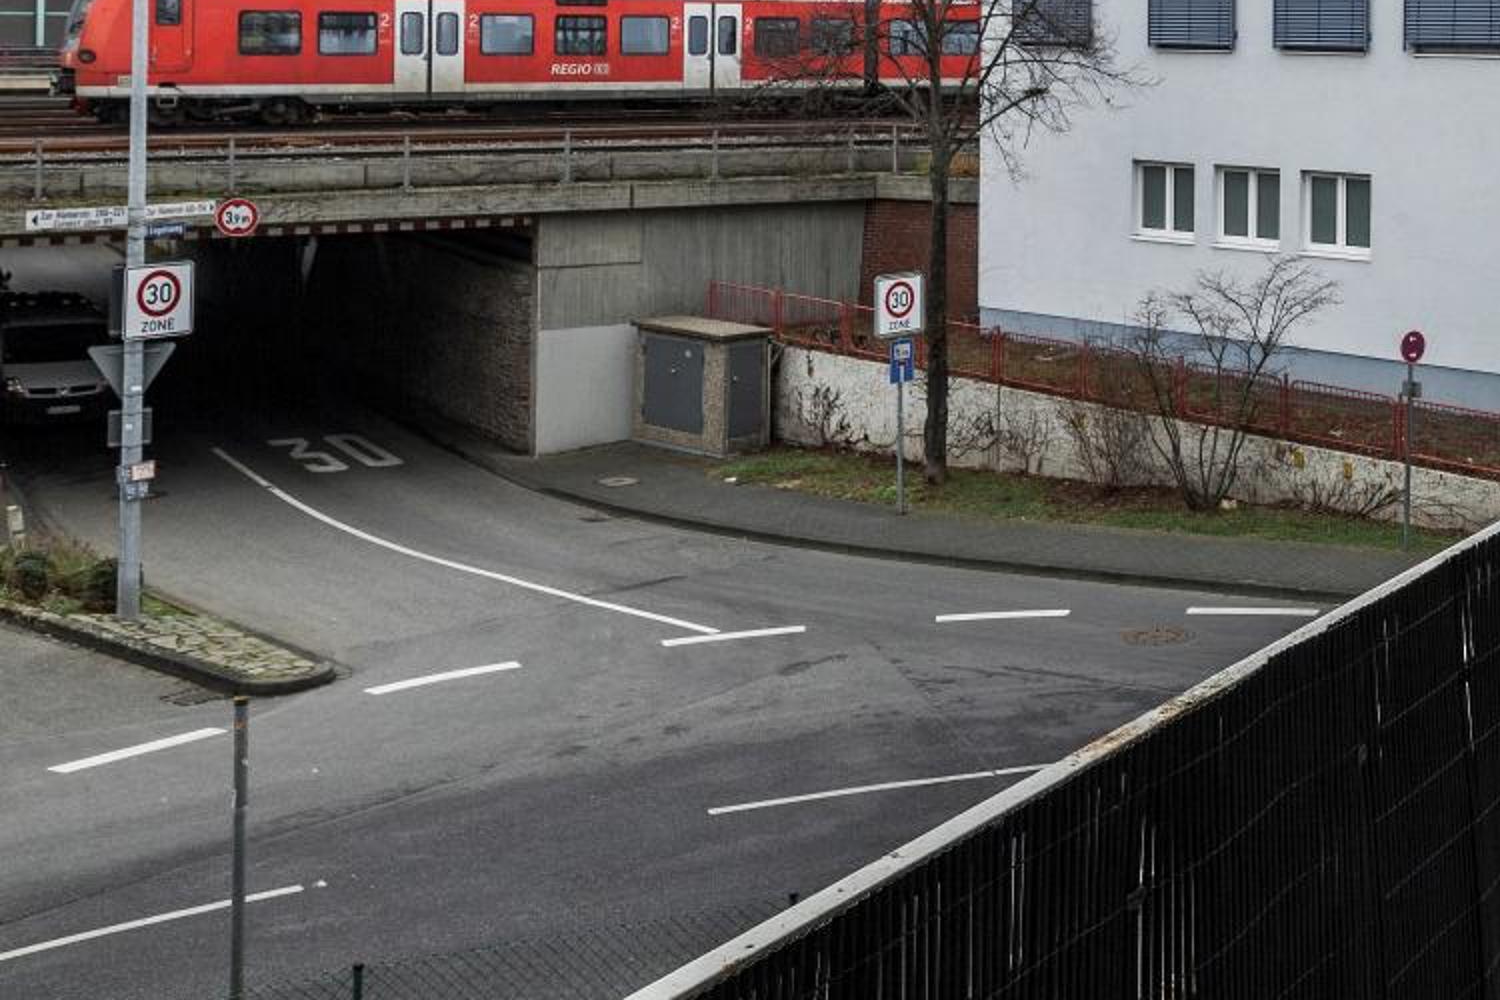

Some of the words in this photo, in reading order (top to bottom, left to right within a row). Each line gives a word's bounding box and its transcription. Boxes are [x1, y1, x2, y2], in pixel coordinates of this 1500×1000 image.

[381, 13, 392, 27] 2
[469, 14, 479, 27] 2
[551, 63, 592, 75] REGIO
[146, 283, 172, 305] 30
[891, 291, 909, 309] 30
[141, 317, 175, 333] ZONE
[889, 319, 911, 331] ZONE
[267, 433, 404, 473] 30
